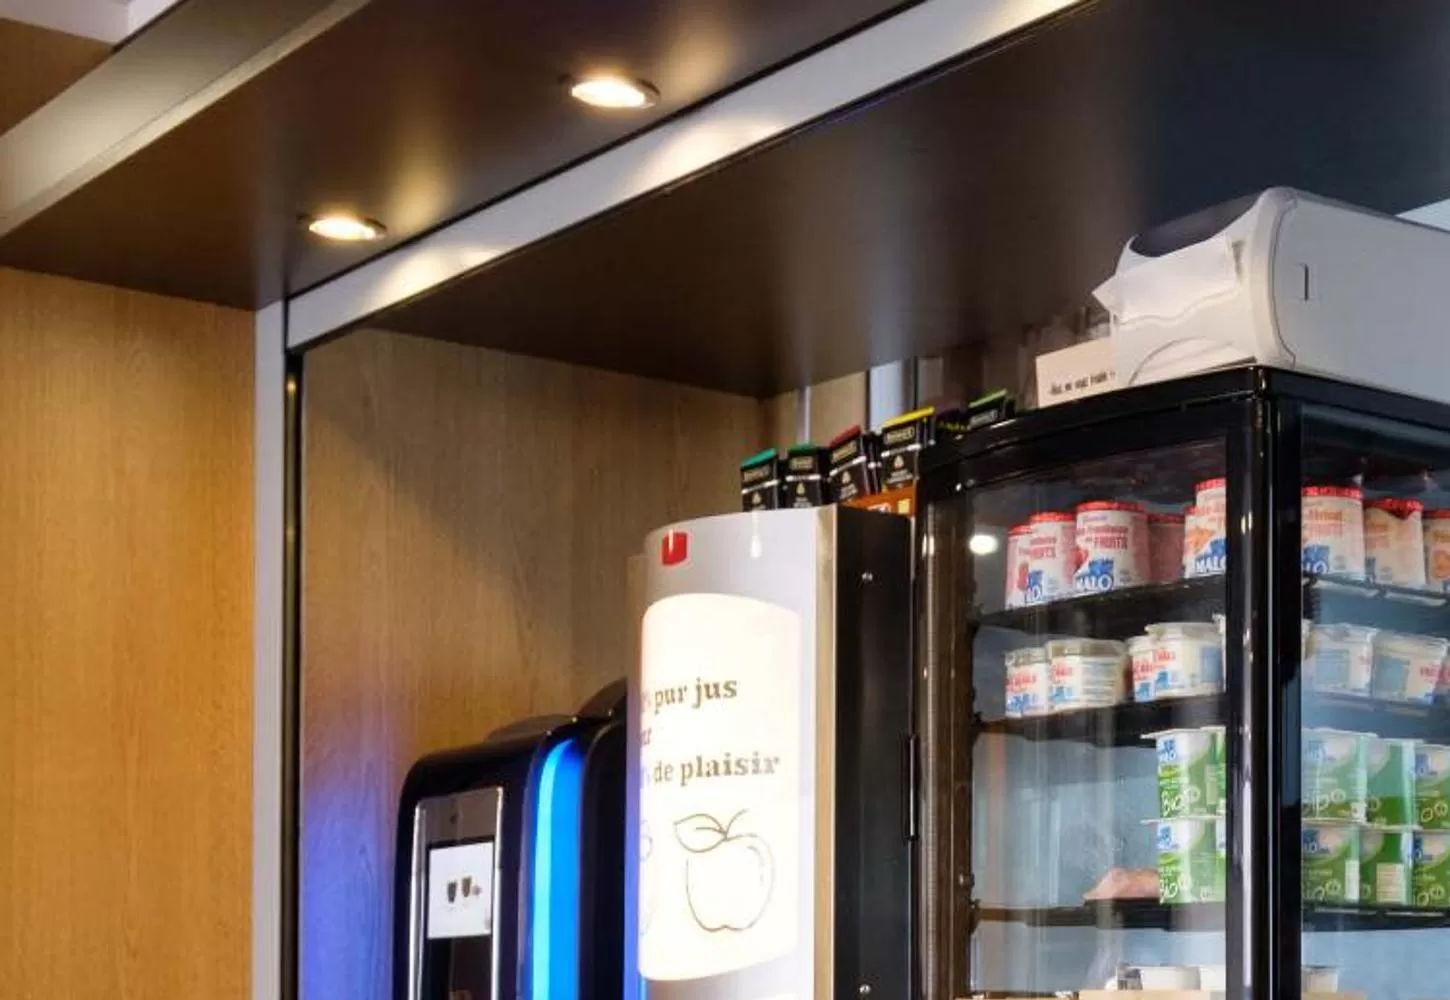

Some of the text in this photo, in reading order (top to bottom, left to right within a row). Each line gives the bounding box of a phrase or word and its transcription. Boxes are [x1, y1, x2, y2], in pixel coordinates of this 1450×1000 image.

[653, 676, 739, 716] pur jus
[653, 751, 781, 787] de plaisir
